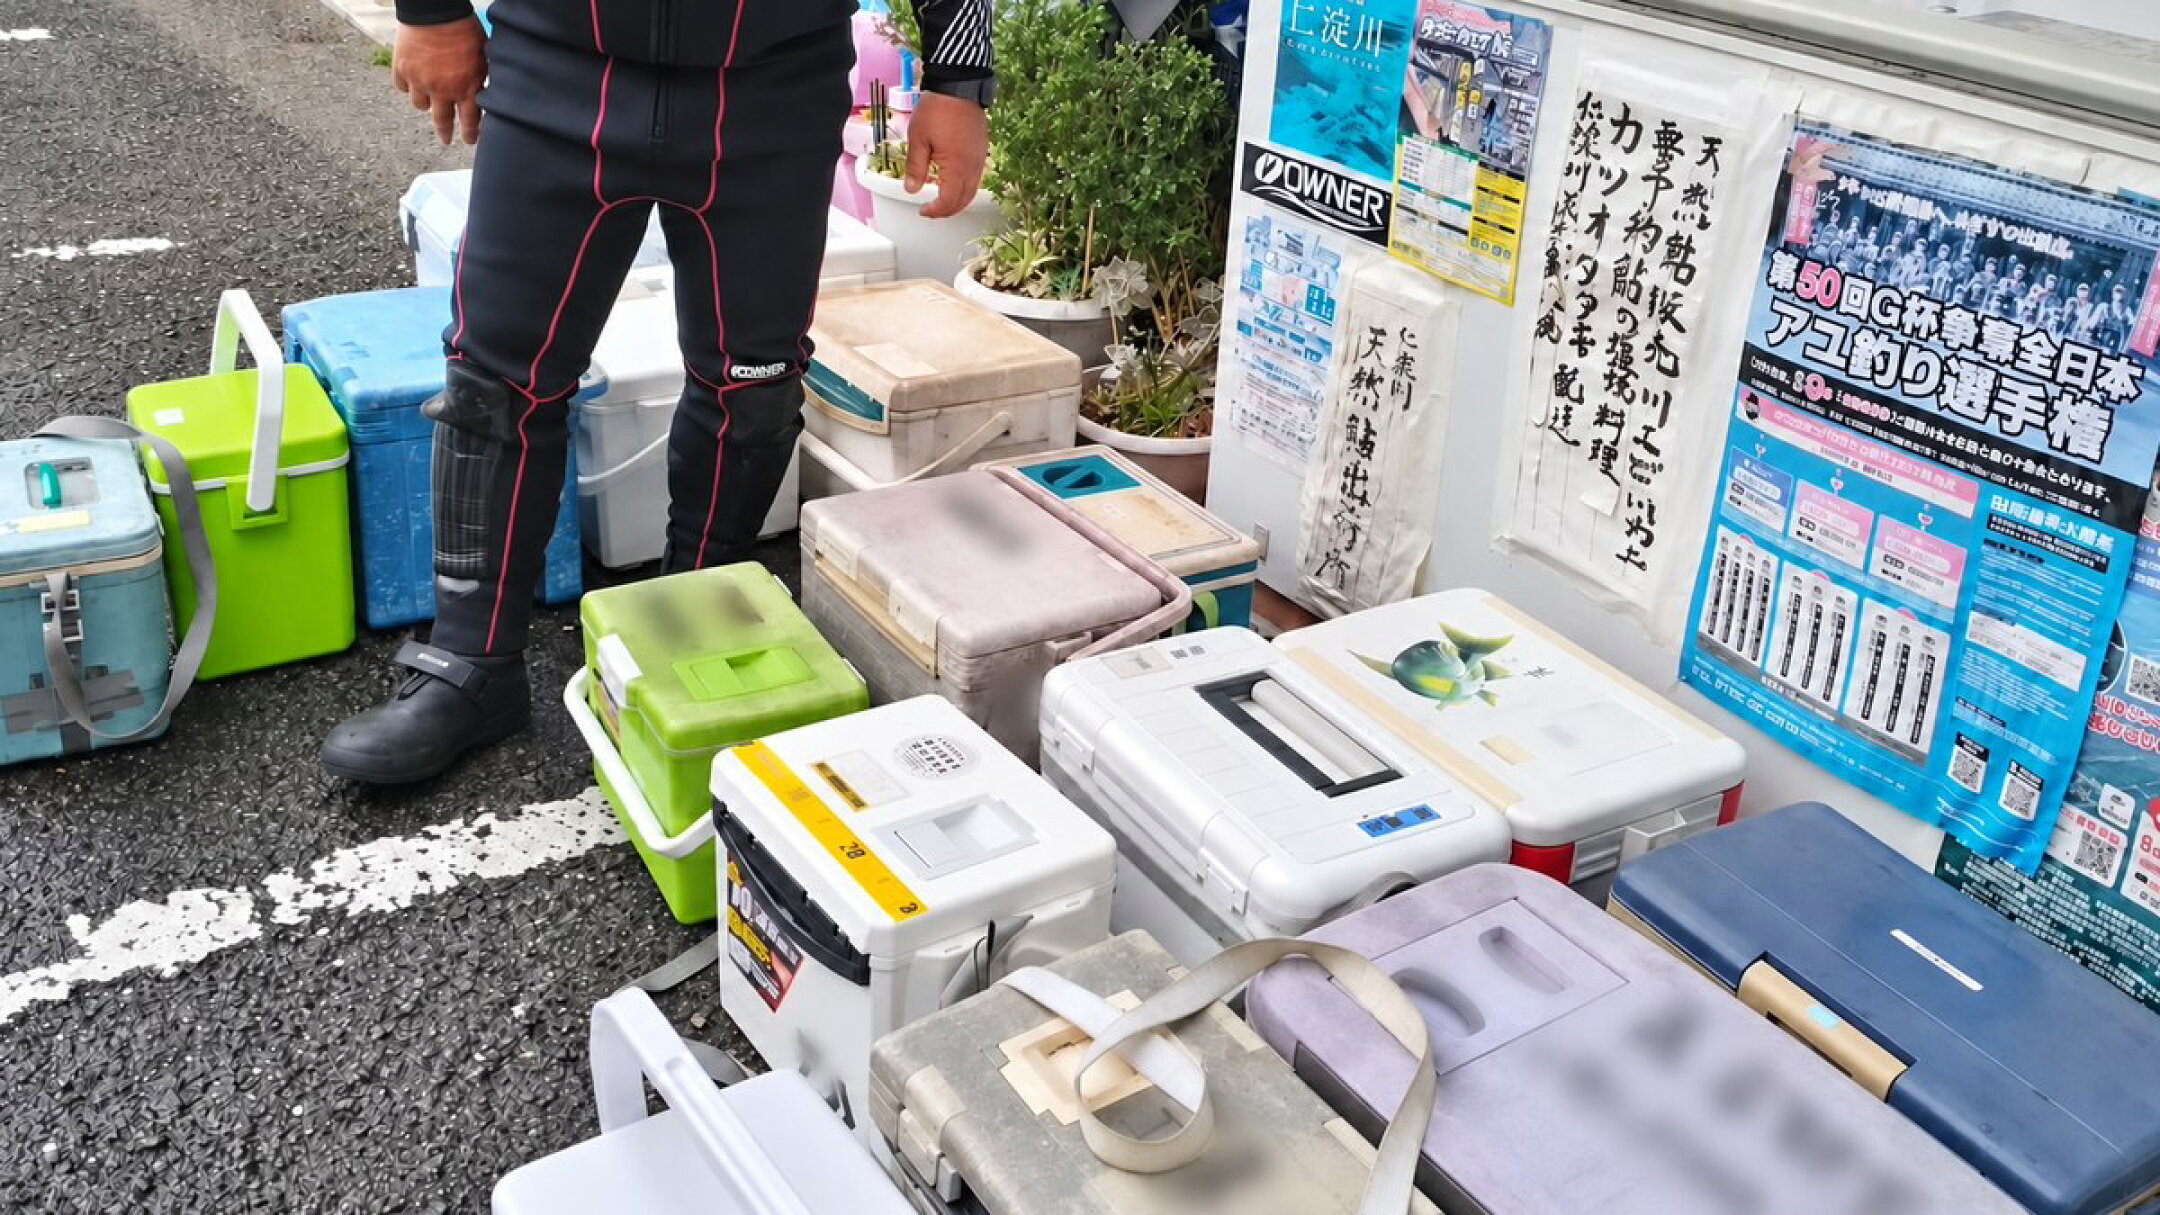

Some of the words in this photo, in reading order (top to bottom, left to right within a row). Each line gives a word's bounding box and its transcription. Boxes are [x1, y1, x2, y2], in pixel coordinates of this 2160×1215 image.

[1284, 162, 1383, 225] OWNER
[739, 362, 786, 378] OWNER
[1766, 298, 2114, 464] アユ釣り選手権
